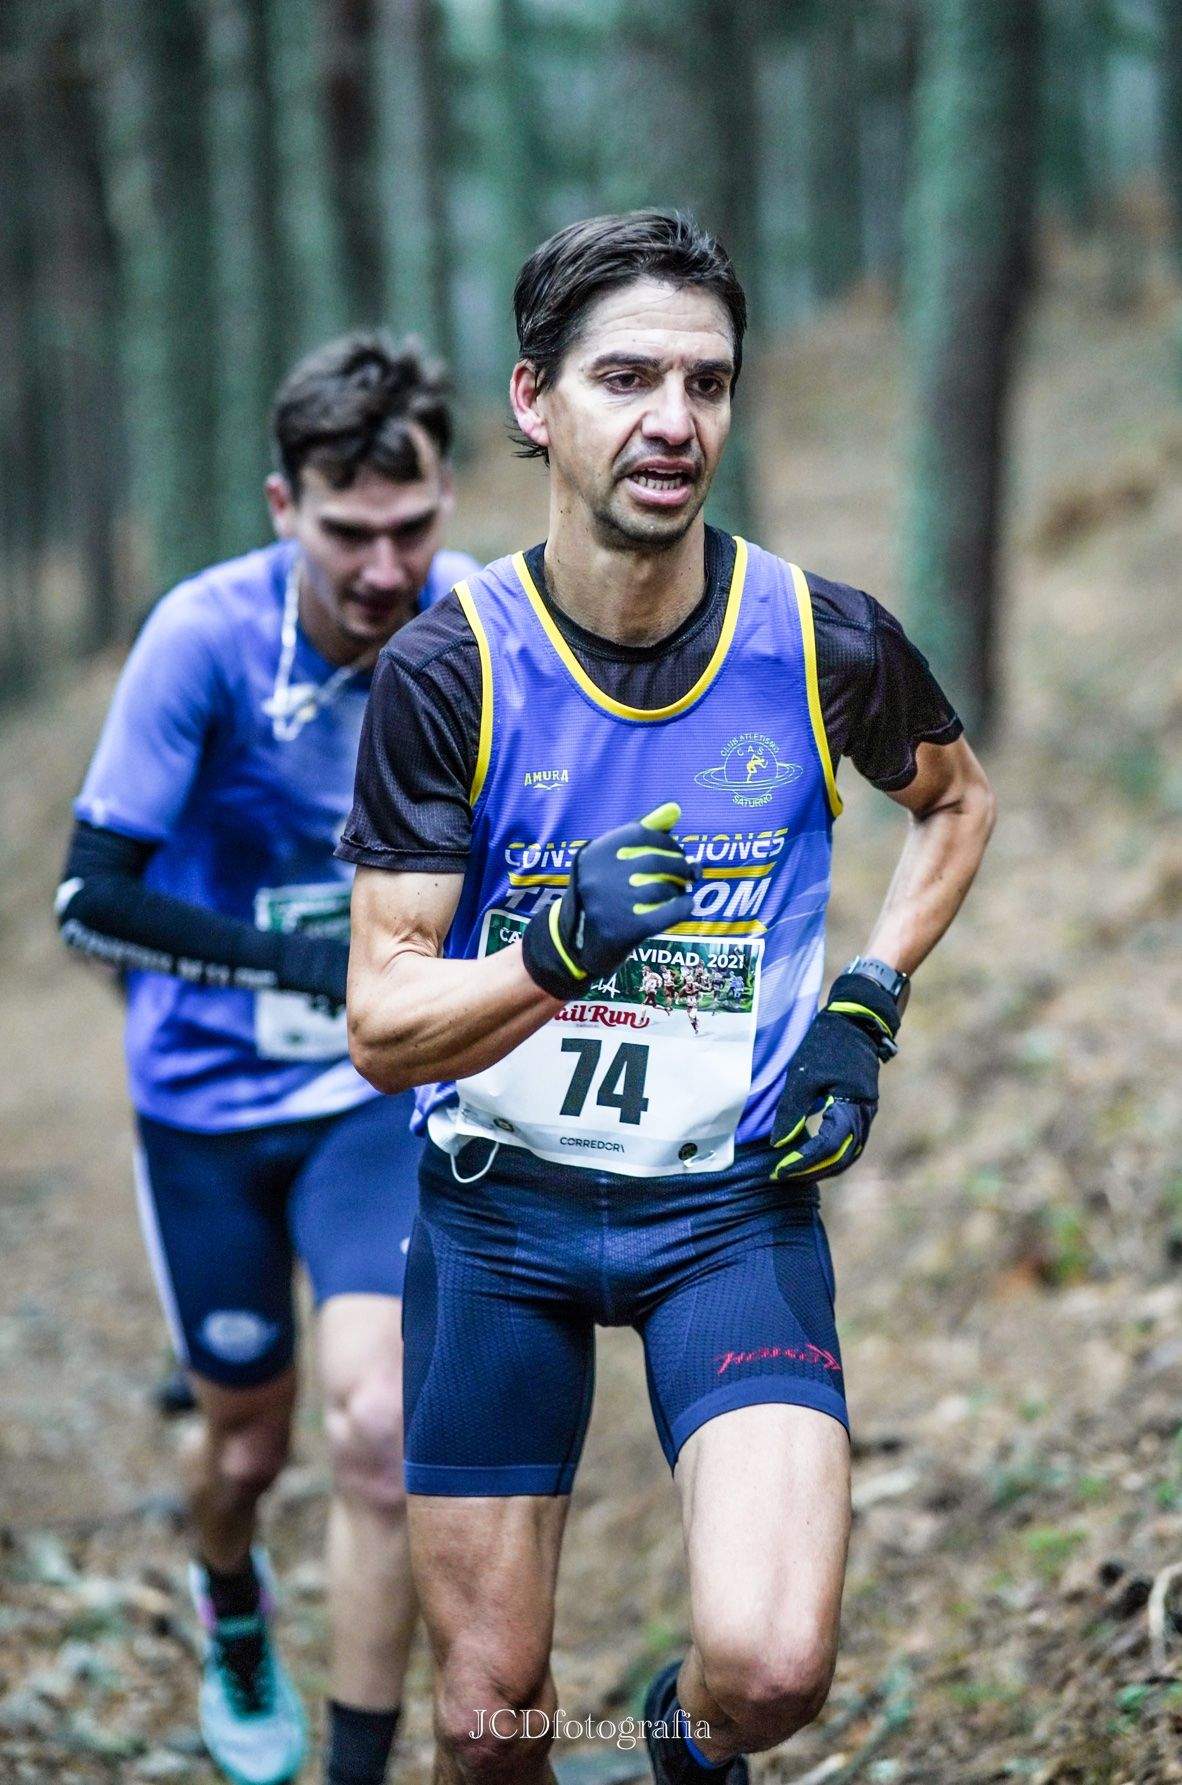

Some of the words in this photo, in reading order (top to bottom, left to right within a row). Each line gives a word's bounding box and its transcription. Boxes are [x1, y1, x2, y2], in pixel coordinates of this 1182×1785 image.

[524, 769, 569, 786] AMURA
[731, 793, 773, 808] SATURNO
[627, 947, 700, 967] AVIDAD
[707, 953, 745, 969] 2021
[559, 1037, 650, 1126] 74
